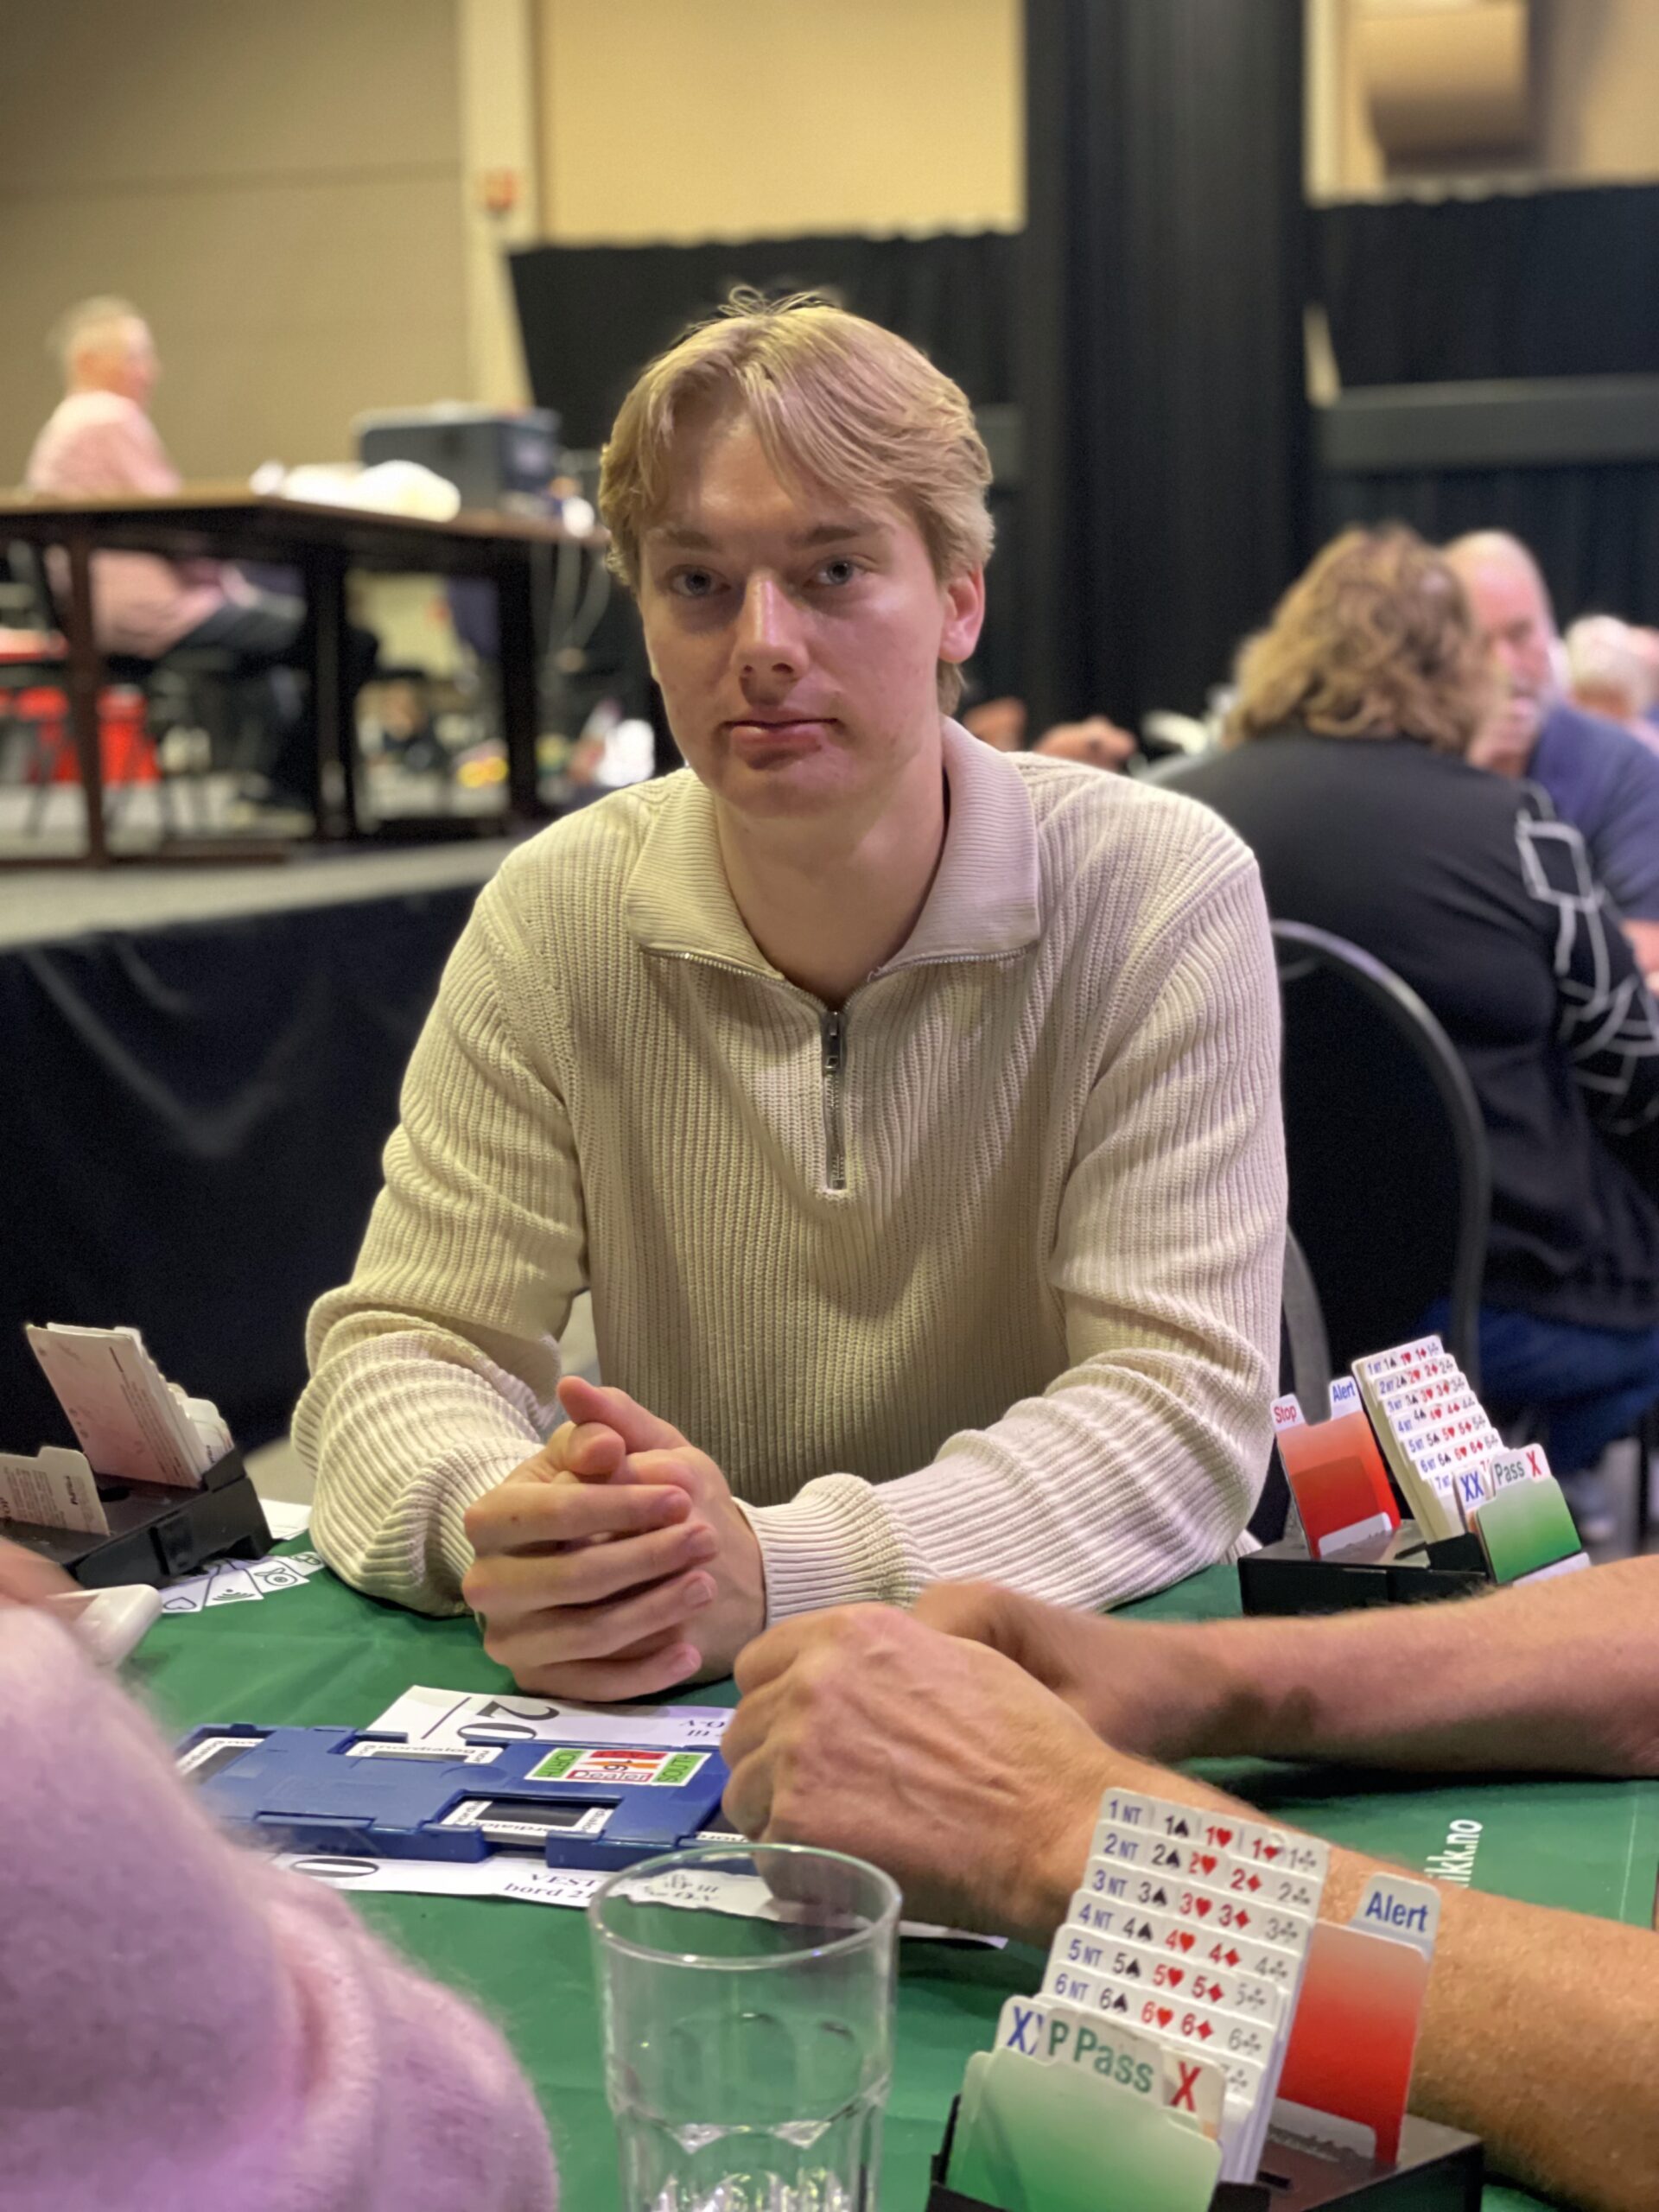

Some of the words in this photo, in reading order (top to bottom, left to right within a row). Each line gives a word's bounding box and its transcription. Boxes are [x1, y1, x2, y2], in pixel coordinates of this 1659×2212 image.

[1332, 1381, 1356, 1402] Alert
[1274, 1405, 1297, 1424] Stop
[1494, 1461, 1526, 1486] Pass
[1526, 1450, 1542, 1478] X
[1460, 1470, 1484, 1503] XX
[573, 1771, 648, 1782] Dealer
[657, 1752, 691, 1783] SOUTH
[1109, 1799, 1119, 1820] 1
[1122, 1805, 1142, 1825] NT
[1103, 1833, 1118, 1855] 2
[1118, 1840, 1139, 1861] NT
[1424, 1819, 1484, 1889] ikk.no
[503, 1882, 564, 1897] bord
[531, 1872, 602, 1887] VEST
[1092, 1869, 1106, 1891] 3
[1108, 1877, 1128, 1897] NT
[1078, 1903, 1092, 1925] 4
[1094, 1910, 1115, 1931] NT
[1365, 1891, 1428, 1933] Alert
[1067, 1938, 1082, 1961] 5
[1084, 1946, 1104, 1967] NT
[1054, 1974, 1069, 1995] 6
[1069, 1980, 1090, 2002] NT
[1072, 2025, 1154, 2094] Pass
[1169, 2060, 1203, 2113] X
